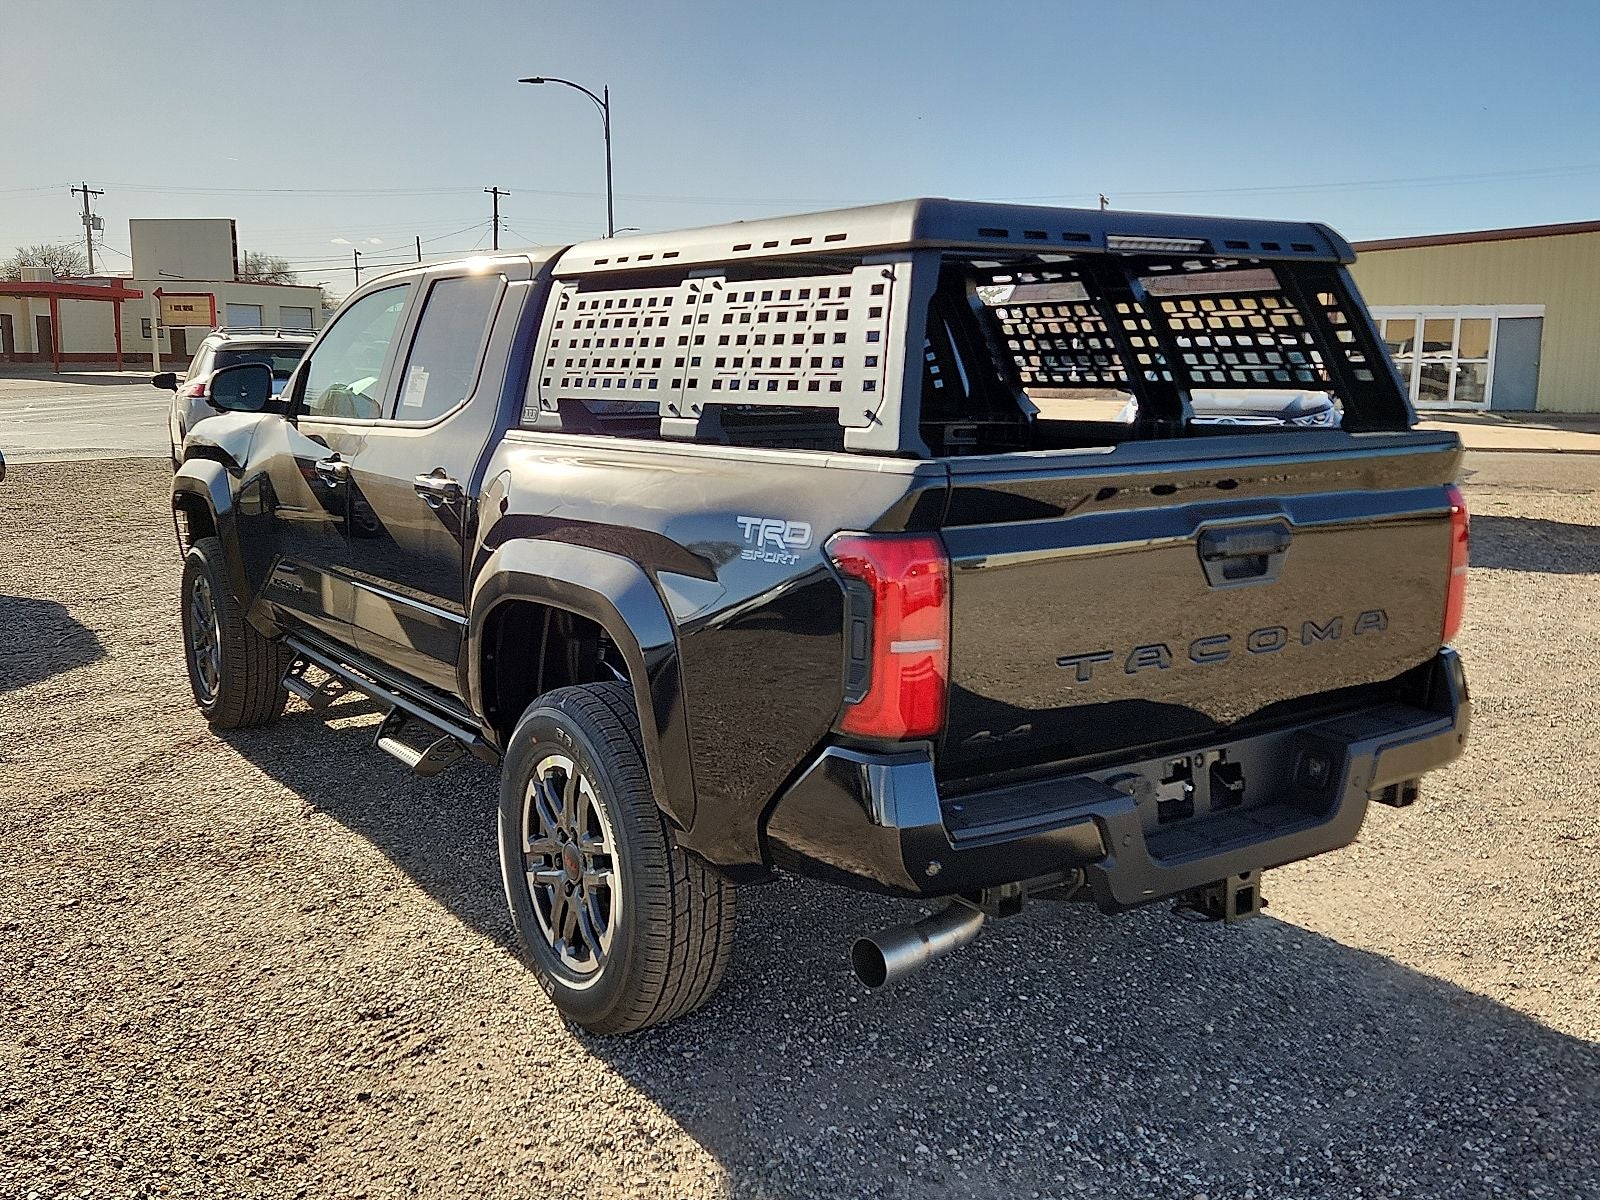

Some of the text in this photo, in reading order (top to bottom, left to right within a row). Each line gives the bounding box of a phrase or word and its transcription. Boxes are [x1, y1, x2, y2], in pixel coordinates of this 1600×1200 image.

[736, 515, 813, 549] TRD
[740, 549, 800, 565] SPORT
[1055, 608, 1390, 683] TACOMA
